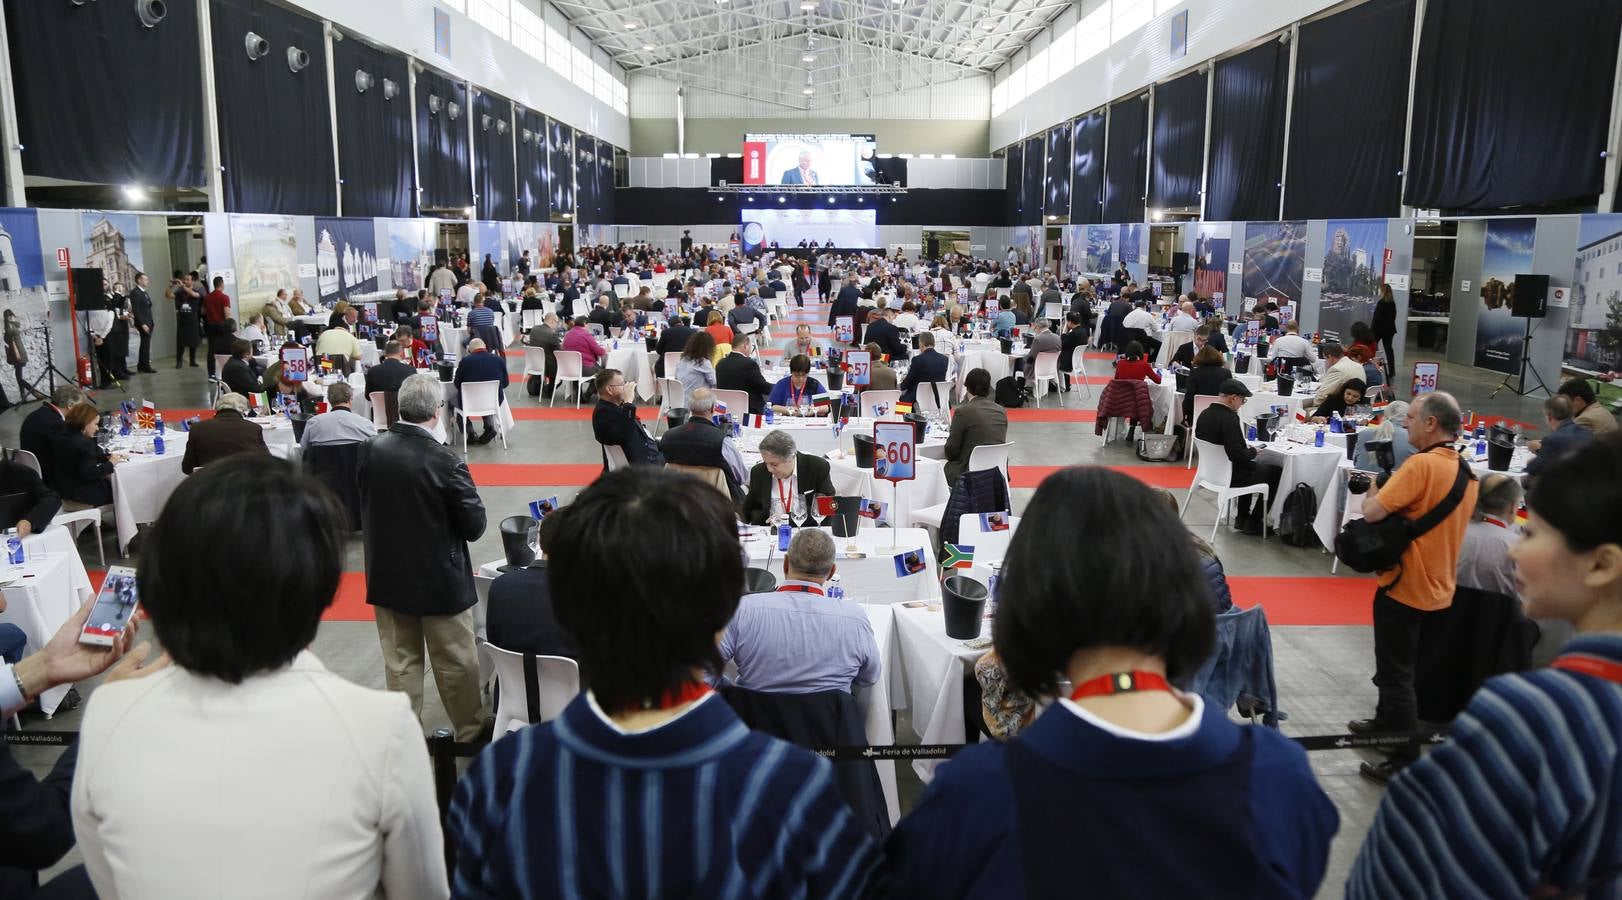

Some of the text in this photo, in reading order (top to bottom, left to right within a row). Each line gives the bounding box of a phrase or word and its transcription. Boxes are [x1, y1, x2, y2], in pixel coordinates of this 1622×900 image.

[426, 324, 435, 334] 55
[841, 325, 852, 335] 54
[290, 360, 305, 373] 58
[855, 363, 868, 376] 57
[1421, 374, 1435, 387] 56
[888, 442, 910, 464] 60
[30, 735, 63, 743] Valladolid
[882, 748, 901, 756] Feria
[911, 747, 946, 755] Valladolid
